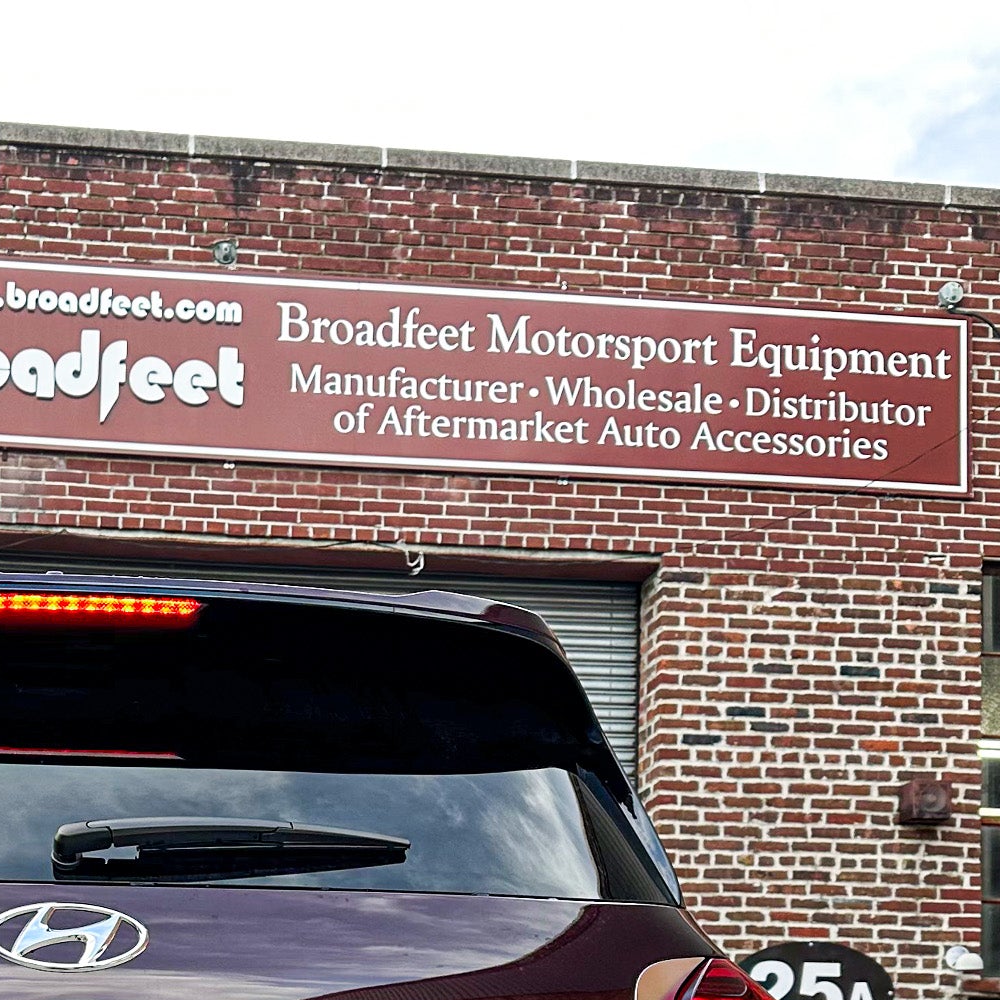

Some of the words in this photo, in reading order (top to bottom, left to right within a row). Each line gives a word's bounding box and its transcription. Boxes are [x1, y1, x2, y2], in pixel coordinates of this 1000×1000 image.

[276, 301, 476, 352] Broadfeet
[486, 313, 718, 370] Motorsport
[730, 327, 952, 381] Equipment
[290, 363, 525, 404] Manufacturer
[545, 376, 723, 415] Wholesale
[746, 387, 932, 427] Distributor
[333, 402, 375, 434] of
[377, 404, 589, 445] Aftermarket
[597, 416, 681, 449] Auto
[690, 421, 888, 460] Accessories
